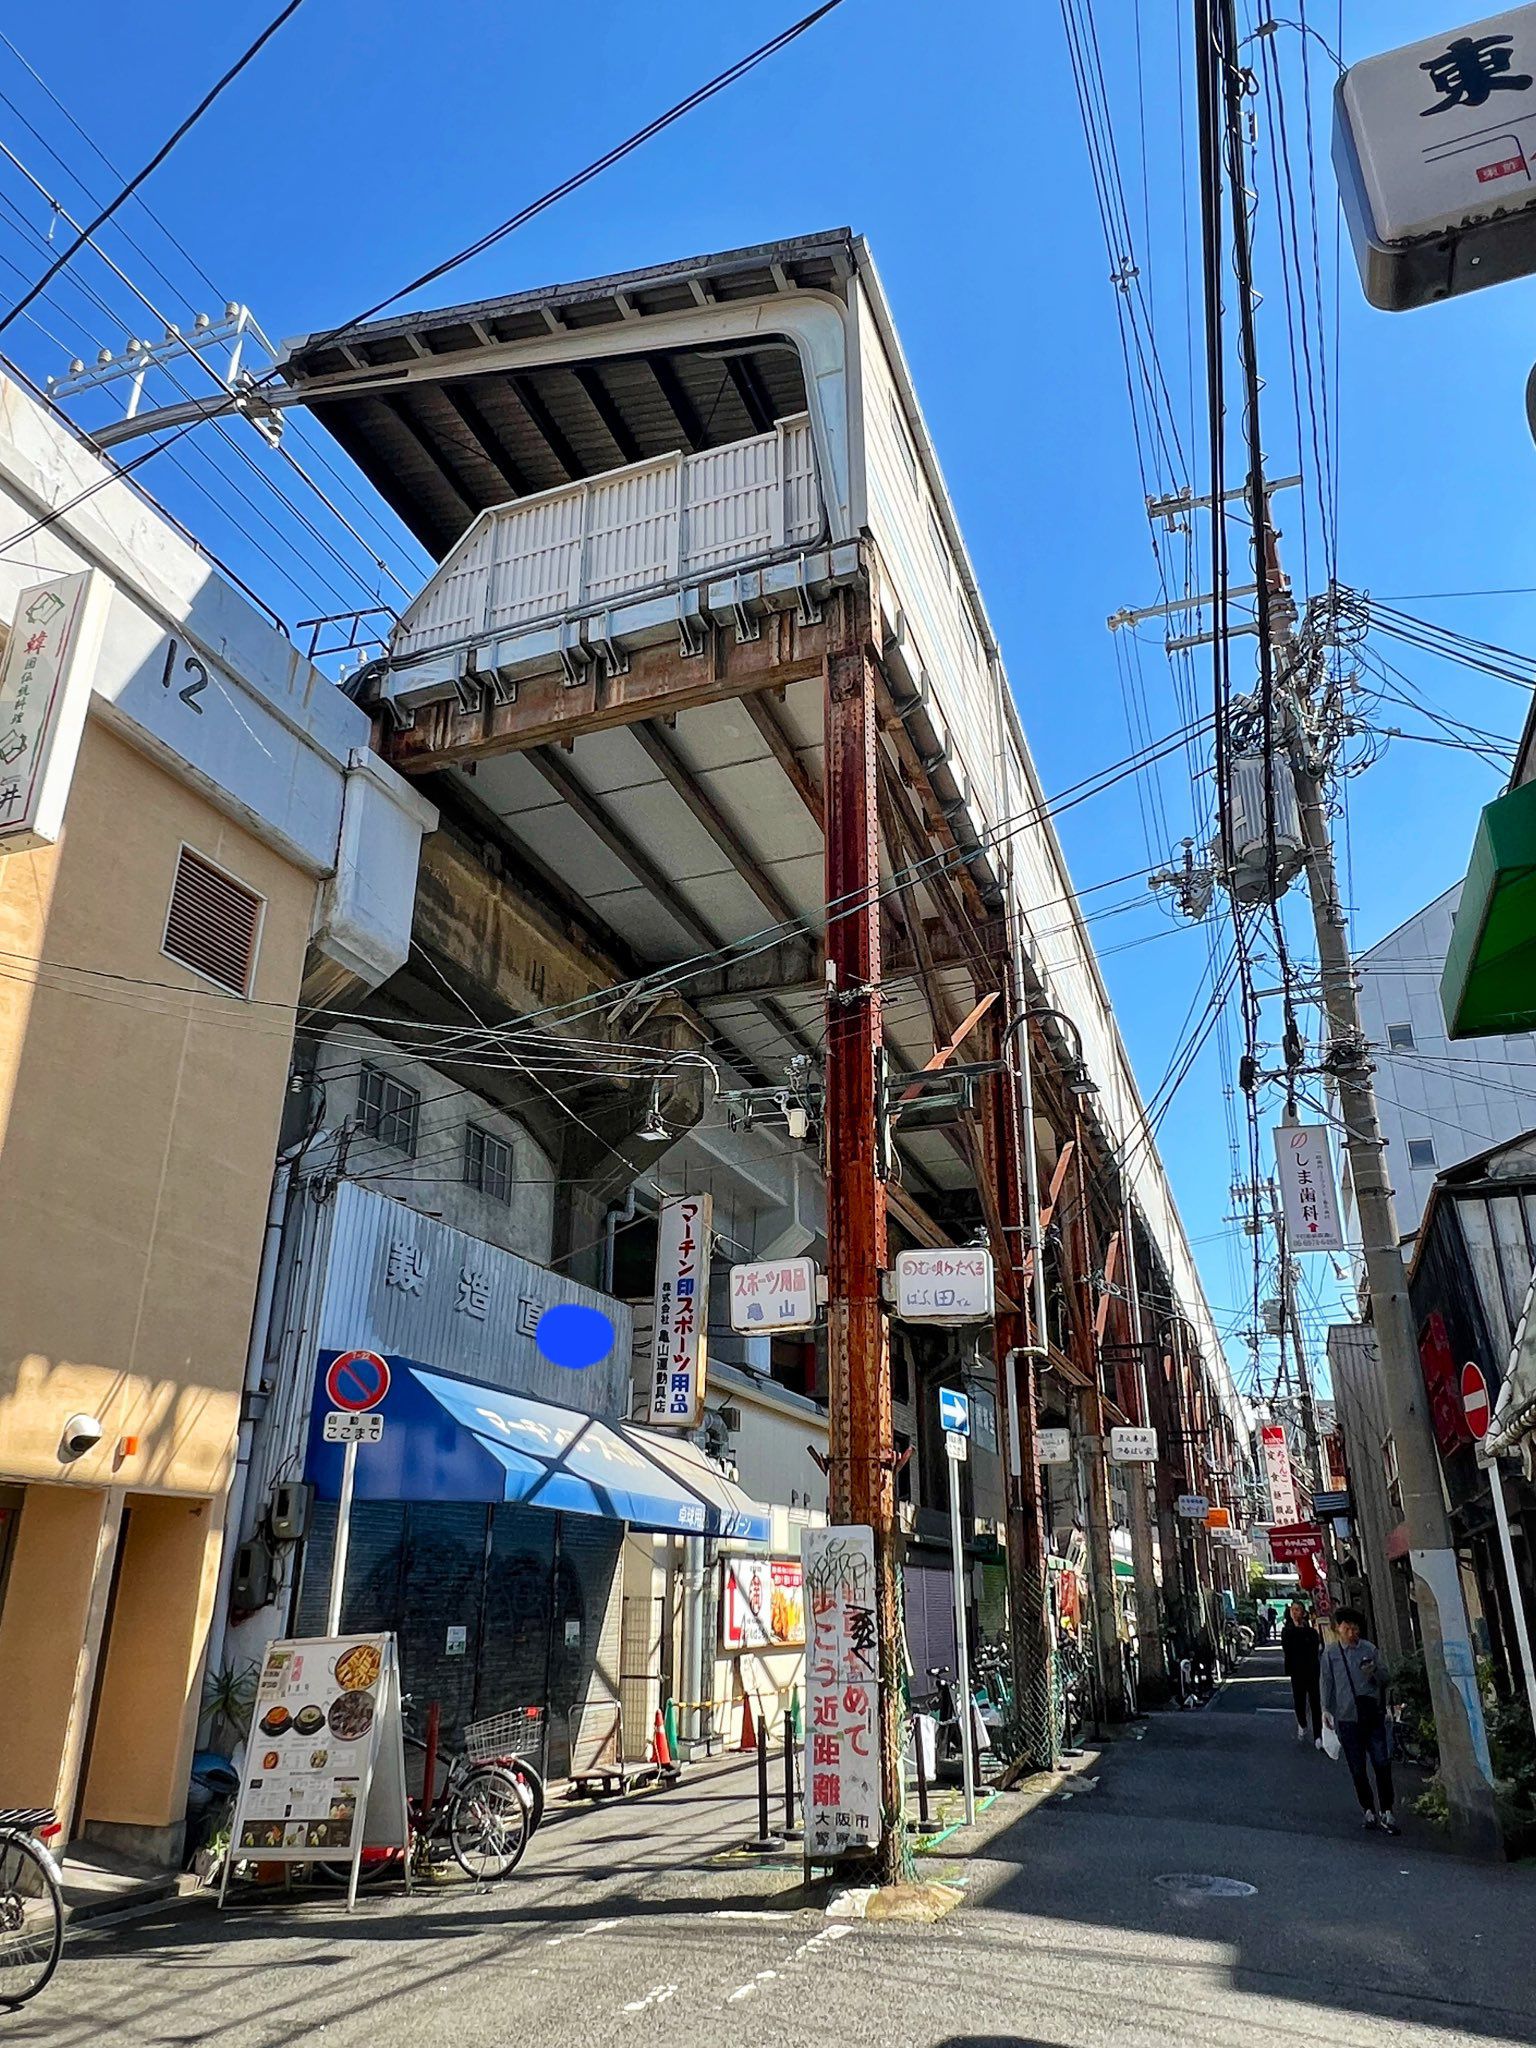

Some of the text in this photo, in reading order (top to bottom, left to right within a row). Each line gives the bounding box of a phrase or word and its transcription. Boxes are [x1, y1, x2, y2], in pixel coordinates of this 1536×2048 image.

[162, 639, 209, 715] 12
[1296, 1152, 1319, 1221] しま歯科
[735, 1268, 806, 1297] スポーツ用品
[670, 1204, 699, 1413] マーチン印スポーツ用品
[747, 1299, 796, 1320] 亀山
[654, 1282, 672, 1413] 株式会社 亀山運動具店
[326, 1427, 380, 1440] ここまで
[815, 1810, 870, 1829] 大阪市
